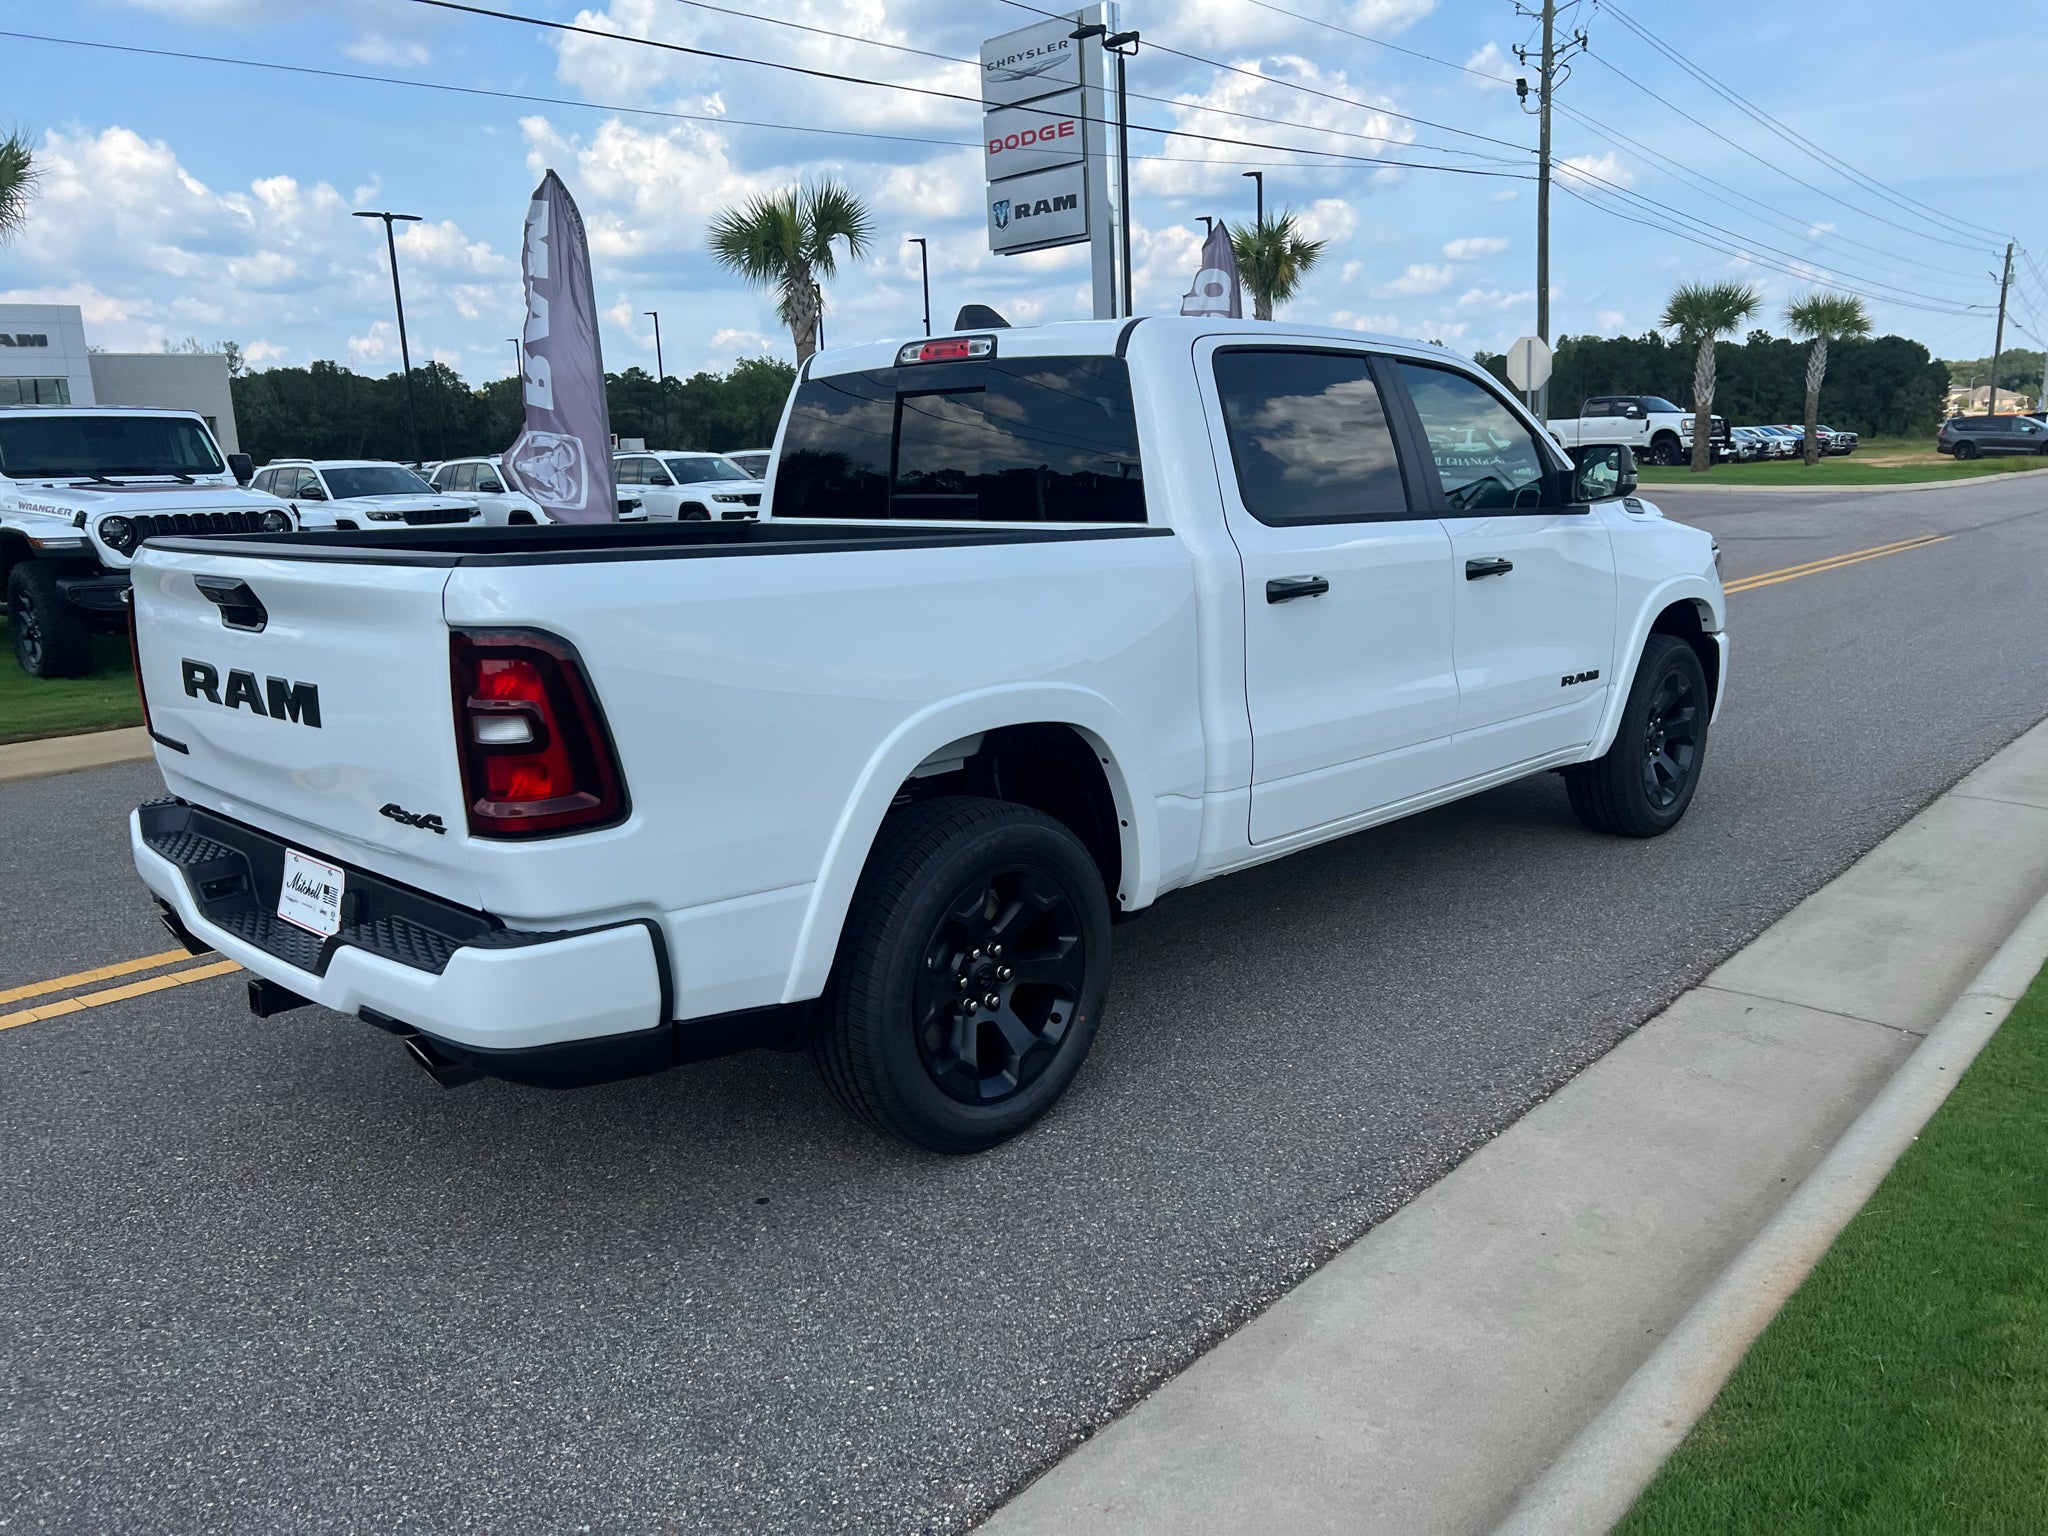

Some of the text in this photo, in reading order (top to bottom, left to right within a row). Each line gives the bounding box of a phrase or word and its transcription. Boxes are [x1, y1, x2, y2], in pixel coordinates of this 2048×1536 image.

[986, 39, 1069, 72] CHRYSLER
[988, 120, 1075, 155] DODGE
[1014, 193, 1077, 220] RAM
[0, 333, 48, 347] AM
[18, 501, 72, 517] WRANGLER
[1560, 669, 1600, 687] RAM
[181, 657, 322, 729] RAM
[286, 871, 323, 900] Mitchell
